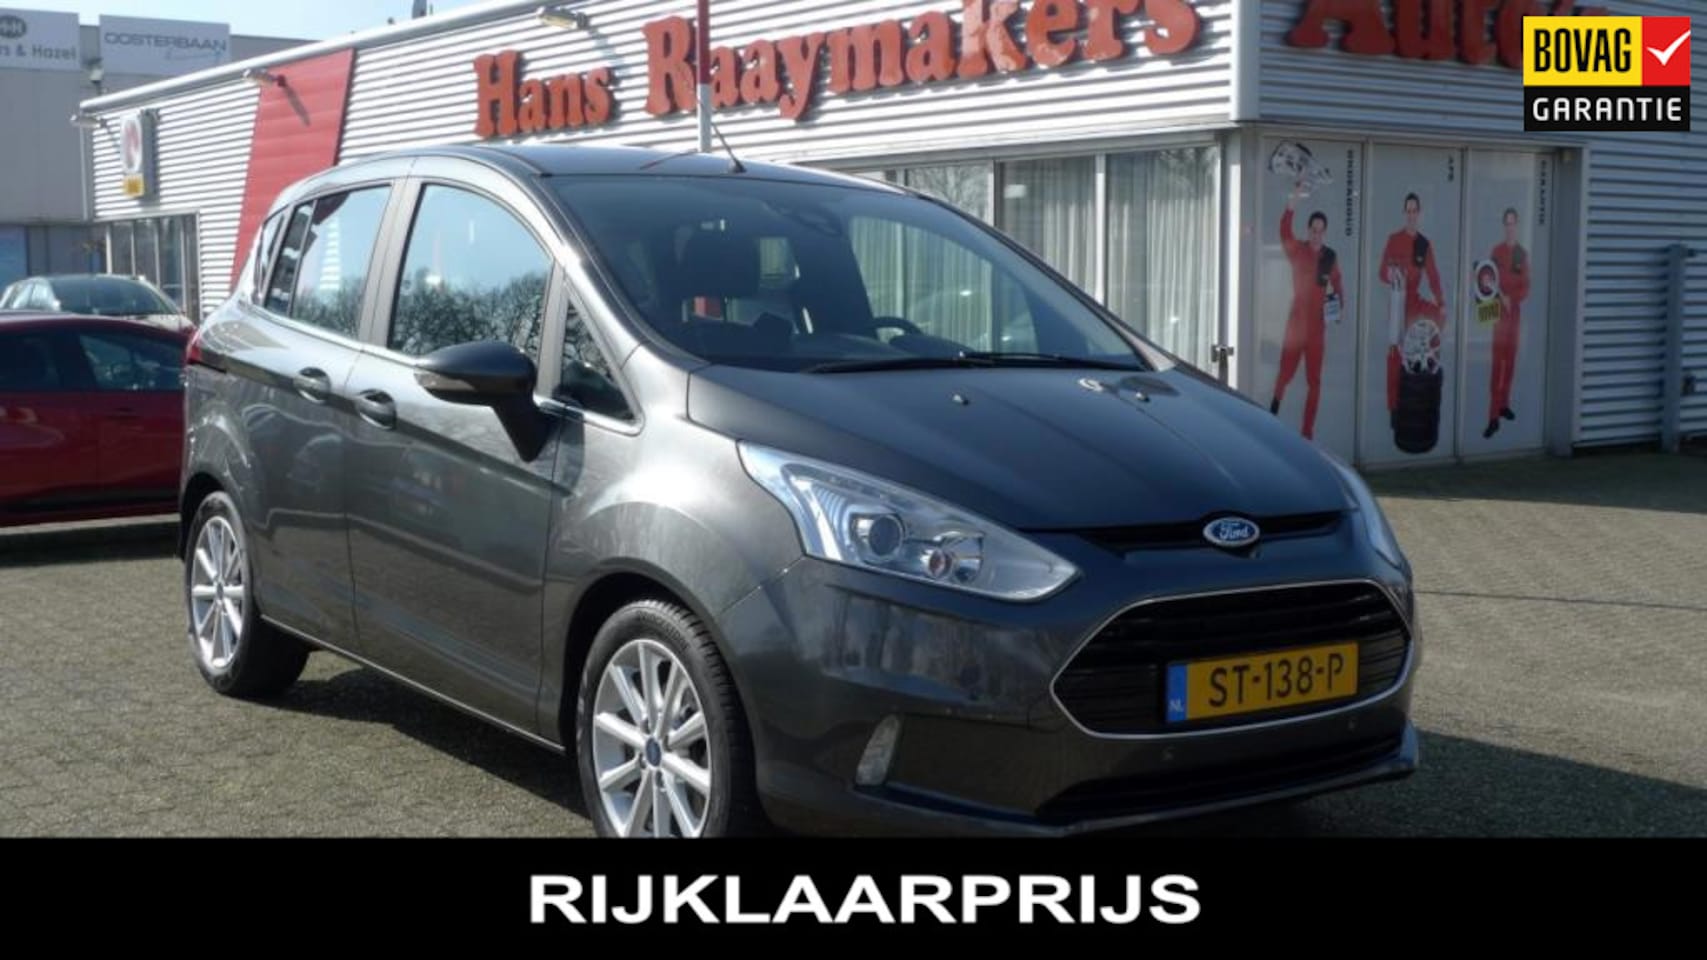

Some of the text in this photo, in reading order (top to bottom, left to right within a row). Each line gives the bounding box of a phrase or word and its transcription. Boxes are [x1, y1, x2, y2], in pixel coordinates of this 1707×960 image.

[104, 32, 226, 51] OOSTERBAAN
[473, 50, 610, 139] Hans
[642, 0, 1197, 120] Raaymakers
[1219, 522, 1250, 540] Ford
[1169, 653, 1344, 711] NL ST-138-P
